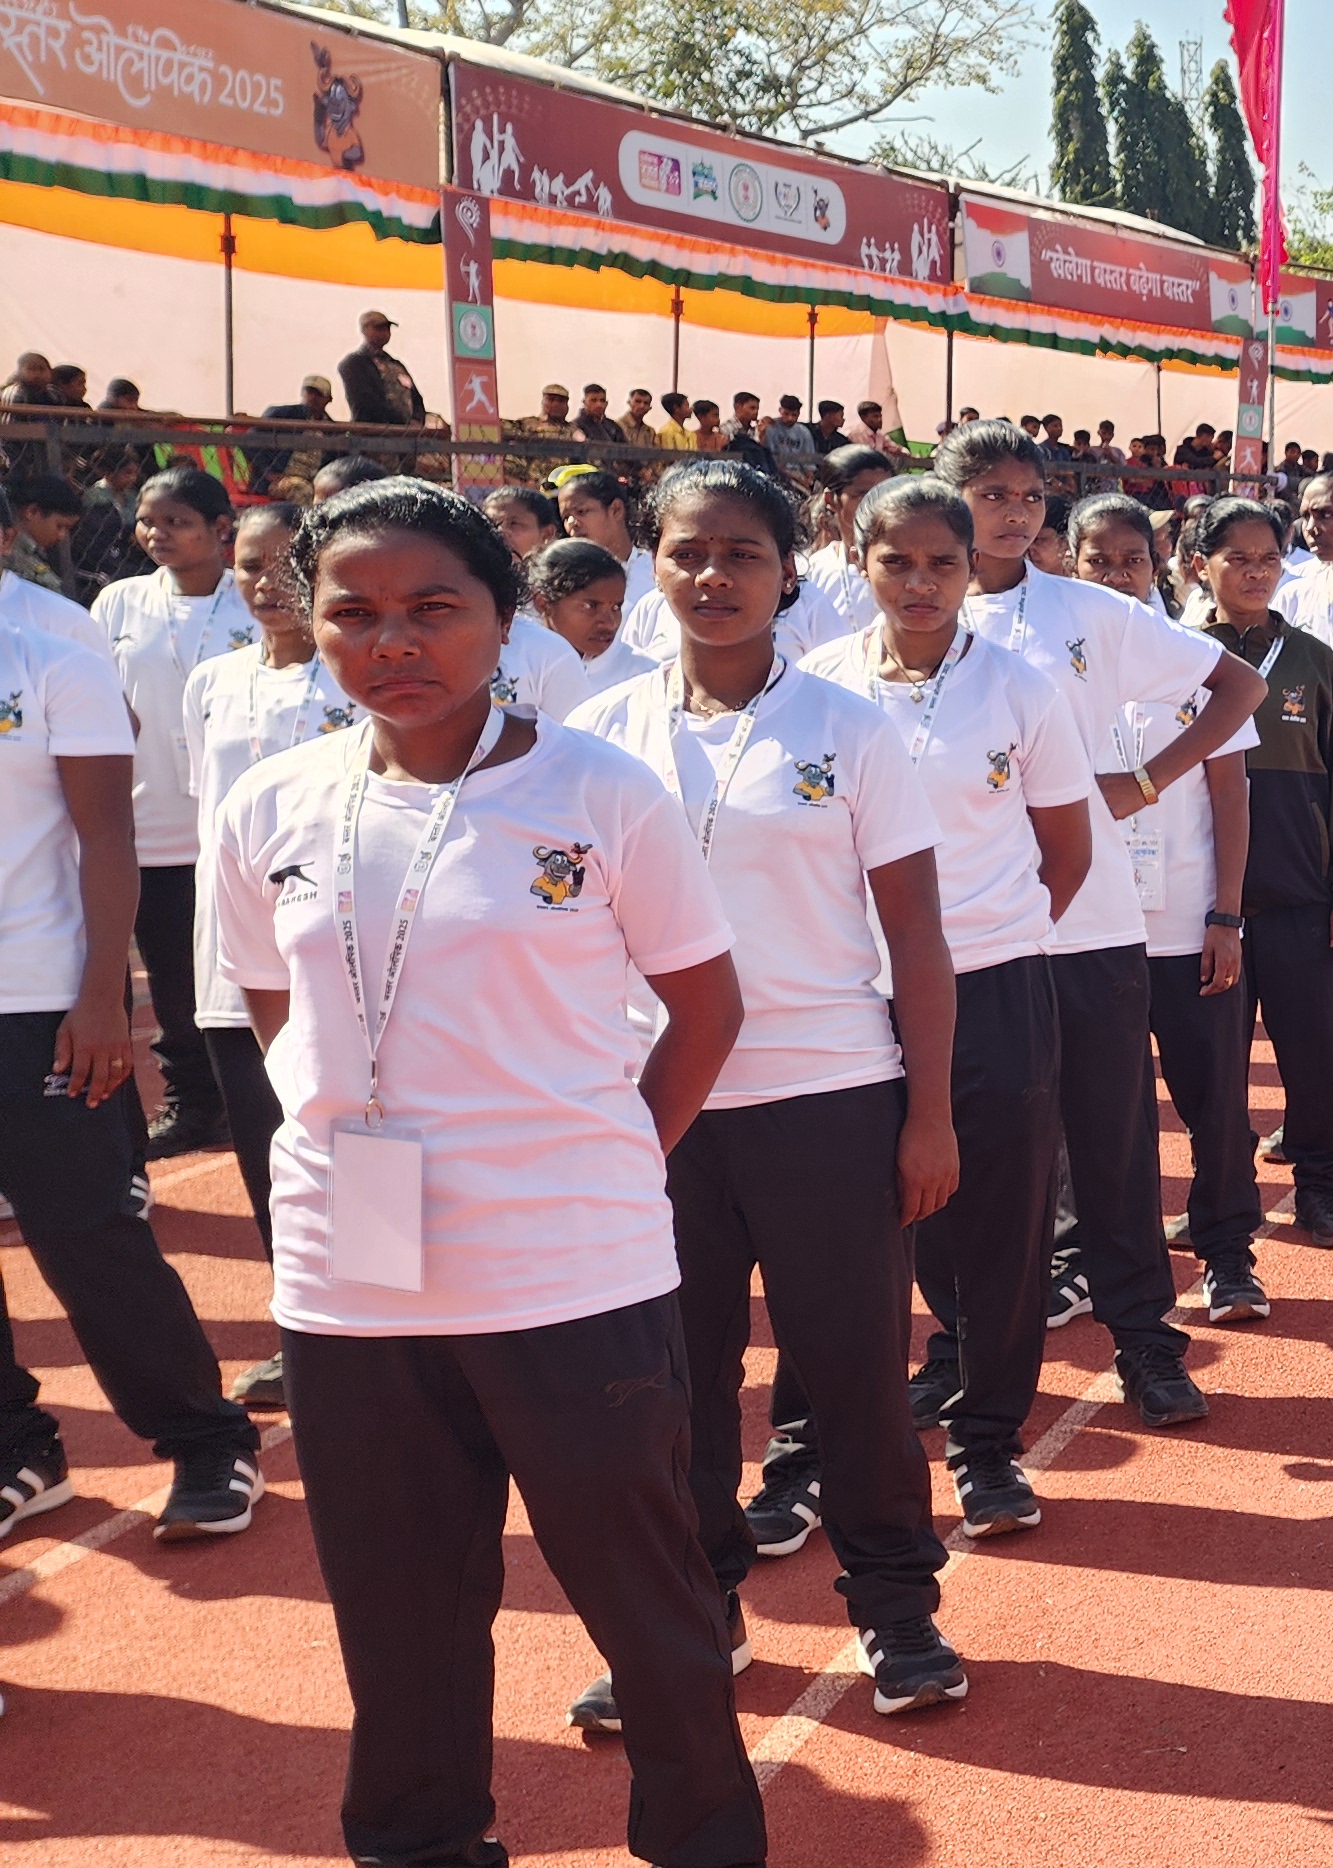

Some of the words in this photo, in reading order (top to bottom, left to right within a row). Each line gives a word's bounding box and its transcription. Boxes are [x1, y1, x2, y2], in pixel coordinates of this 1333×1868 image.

[0, 4, 71, 96] स्तर
[69, 0, 214, 108] ओलंपिक
[218, 64, 285, 117] 2025
[1093, 260, 1128, 292] बस्तर
[1128, 261, 1161, 301] बढ़ेगा
[342, 919, 354, 942] 2025
[396, 918, 409, 942] 2025
